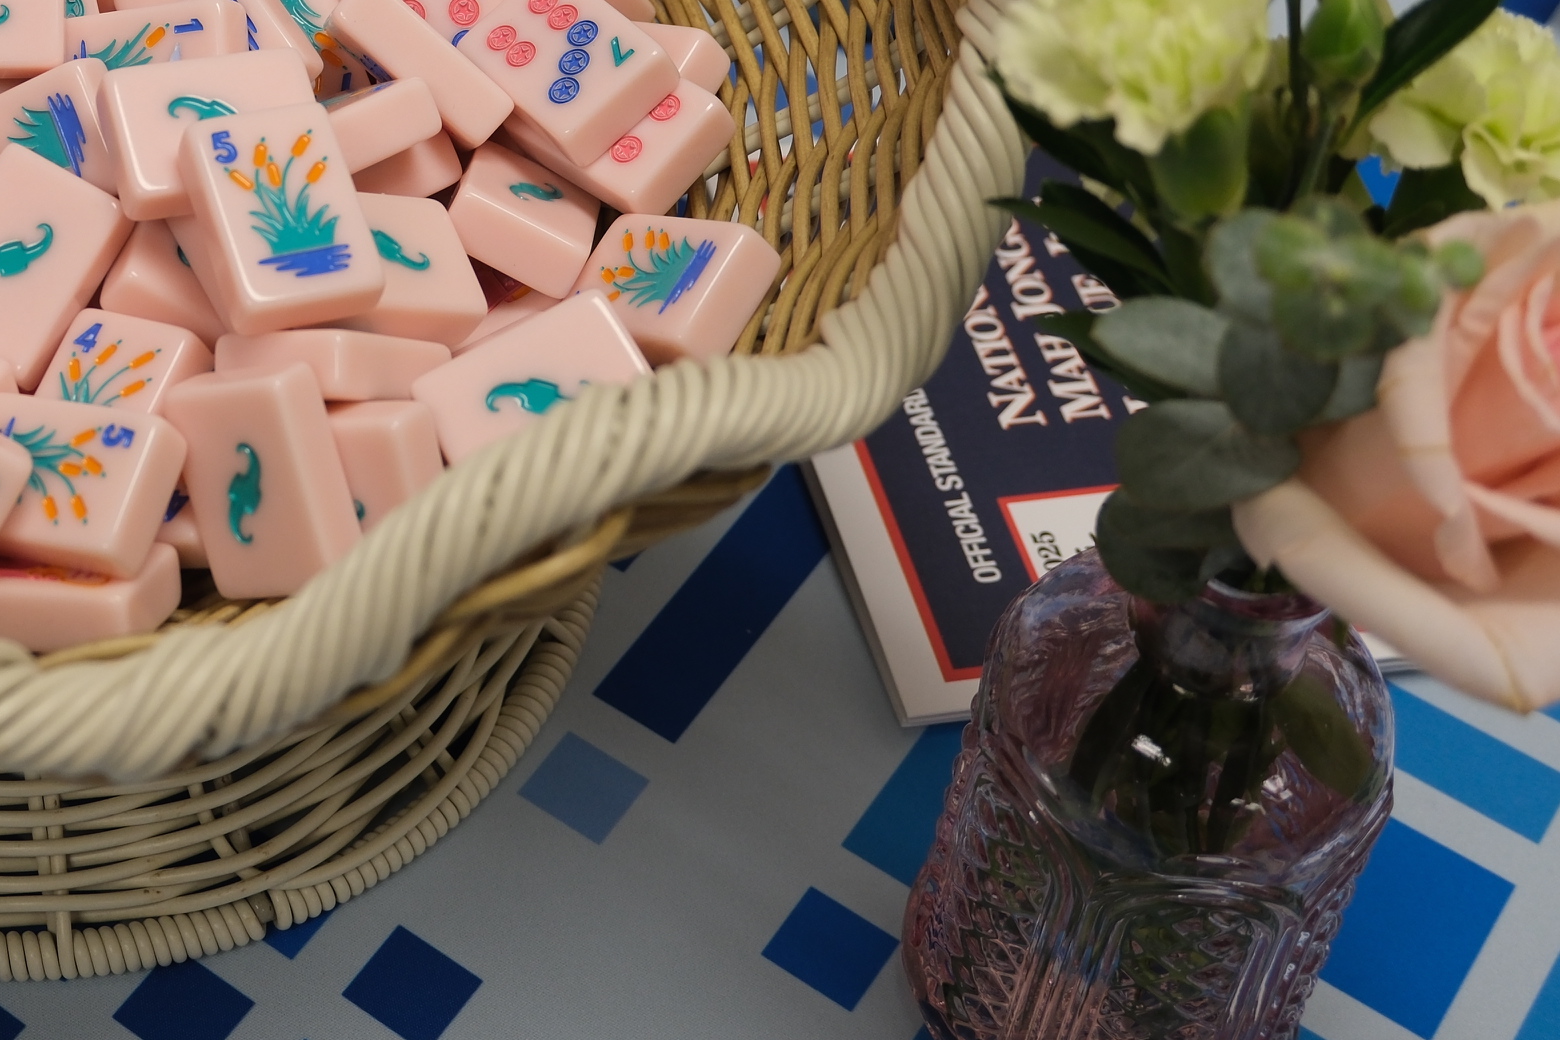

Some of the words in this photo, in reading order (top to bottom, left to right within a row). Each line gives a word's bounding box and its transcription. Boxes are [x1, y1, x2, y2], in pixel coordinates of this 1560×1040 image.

[173, 17, 204, 35] 1
[609, 35, 635, 68] 7
[210, 129, 238, 165] 5
[72, 322, 104, 354] 4
[963, 283, 1049, 431] NATION
[1033, 332, 1113, 425] MAH
[101, 422, 136, 450] 5
[944, 491, 1002, 585] OFFICIAL
[1030, 531, 1063, 571] 025
